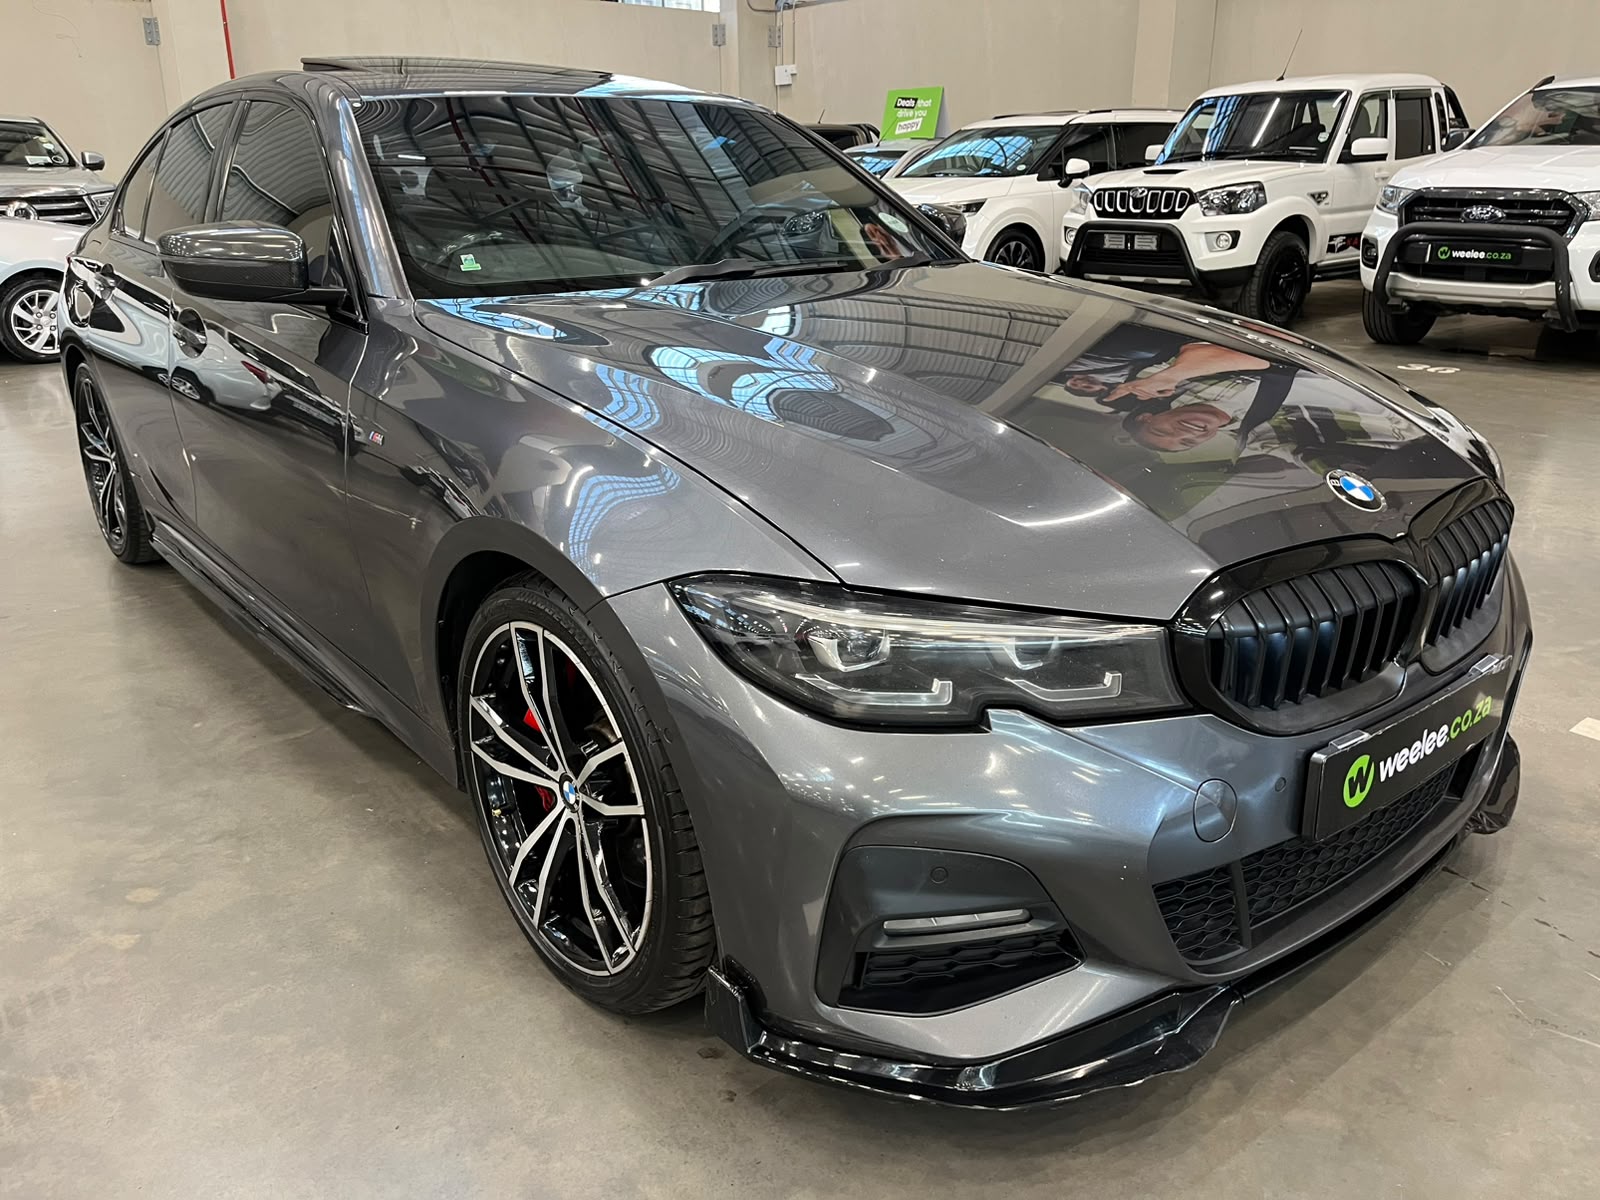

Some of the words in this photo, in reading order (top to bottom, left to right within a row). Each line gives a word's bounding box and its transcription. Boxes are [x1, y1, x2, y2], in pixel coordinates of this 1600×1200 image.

[896, 98, 916, 107] Deals
[917, 98, 932, 107] that
[896, 109, 914, 118] drive
[914, 109, 928, 119] you
[897, 120, 920, 131] happy
[1452, 249, 1511, 260] weelee.co.za
[1380, 696, 1492, 782] weelee.co.za
